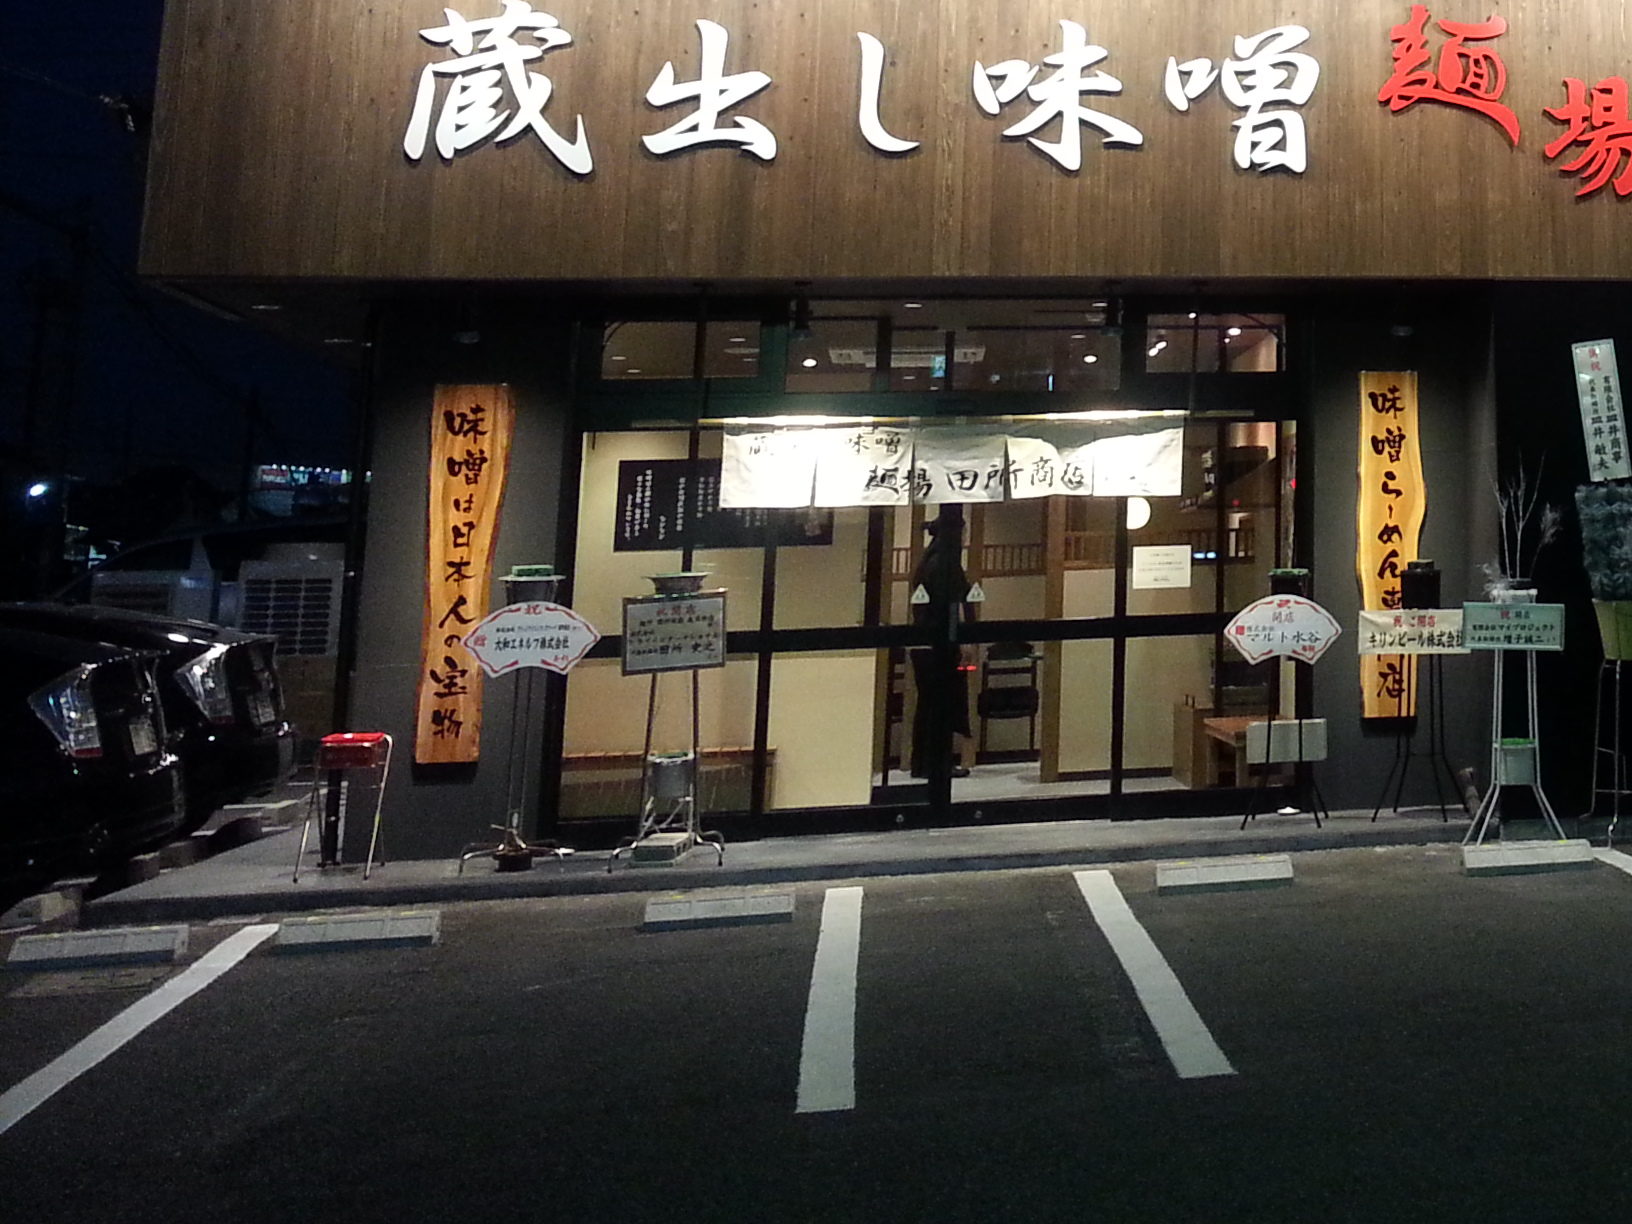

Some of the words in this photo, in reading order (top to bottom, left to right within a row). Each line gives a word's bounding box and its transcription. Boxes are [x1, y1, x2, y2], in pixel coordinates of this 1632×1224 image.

[429, 403, 491, 740] 味噌は日本人の宝物
[1368, 385, 1407, 699] 味噌らーめん専店
